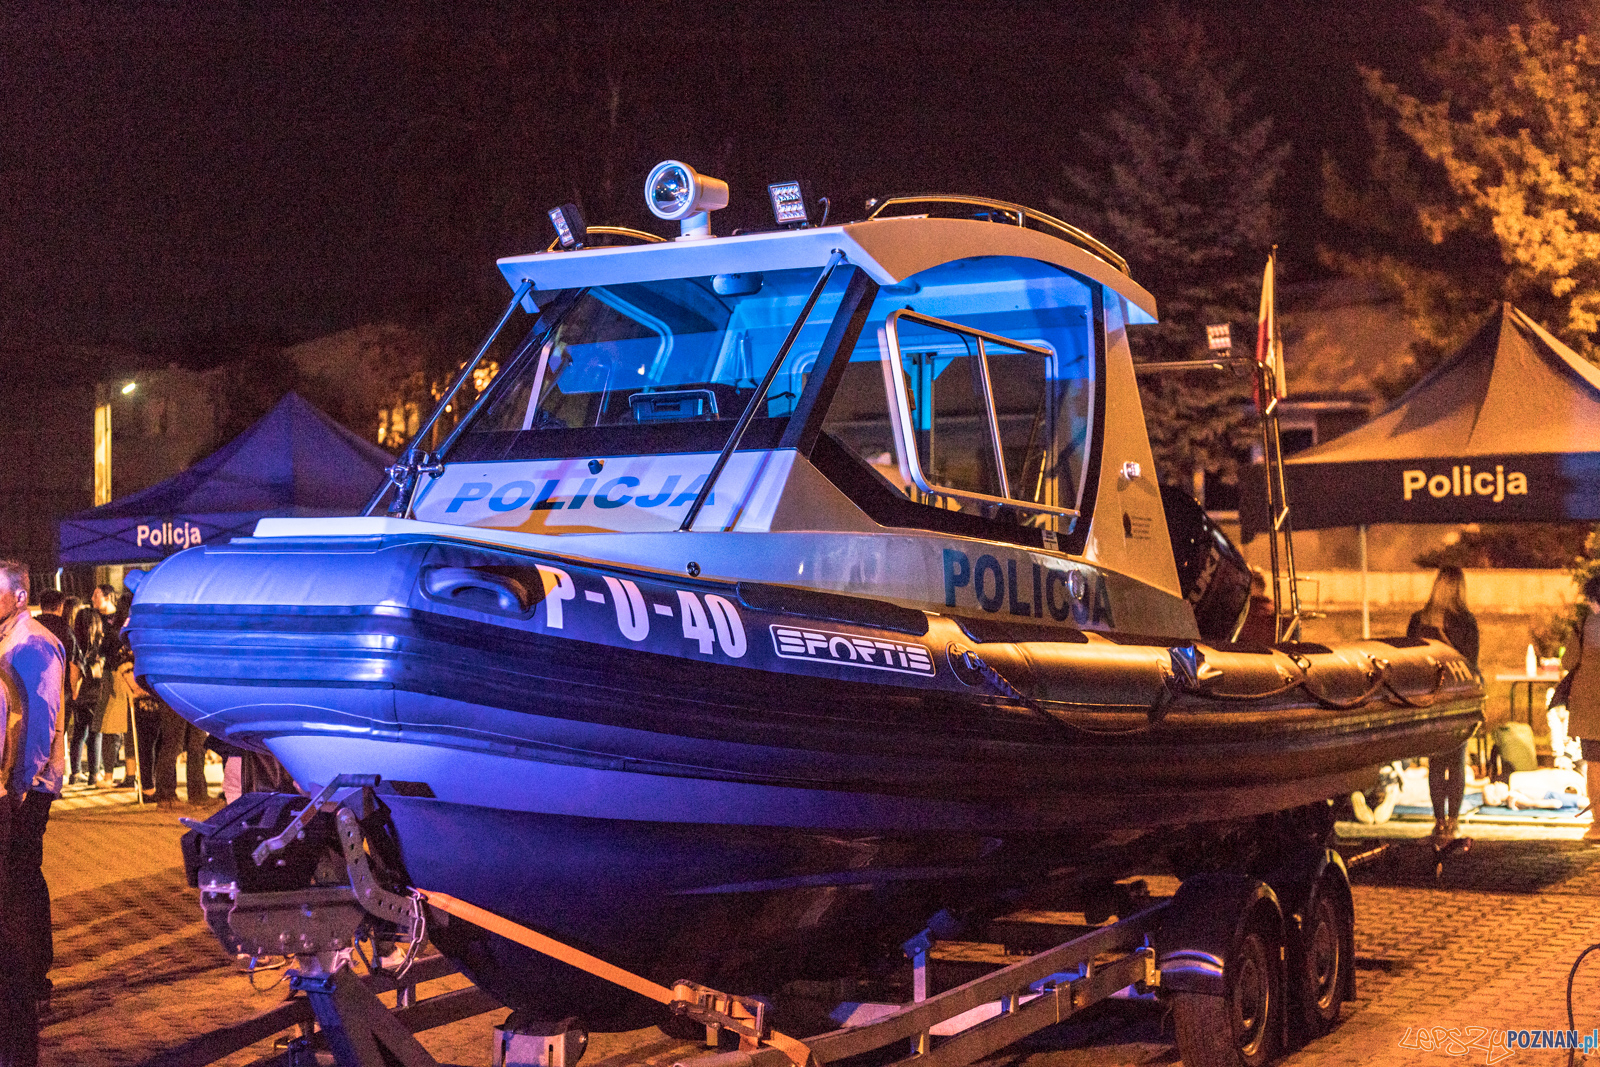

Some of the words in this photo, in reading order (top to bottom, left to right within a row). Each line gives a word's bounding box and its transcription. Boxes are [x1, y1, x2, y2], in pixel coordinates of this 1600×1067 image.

[445, 475, 715, 514] POLICJA
[1403, 466, 1528, 502] Policja
[137, 522, 202, 549] Policja
[534, 564, 748, 659] P-U-40
[777, 629, 932, 671] SPORTIS
